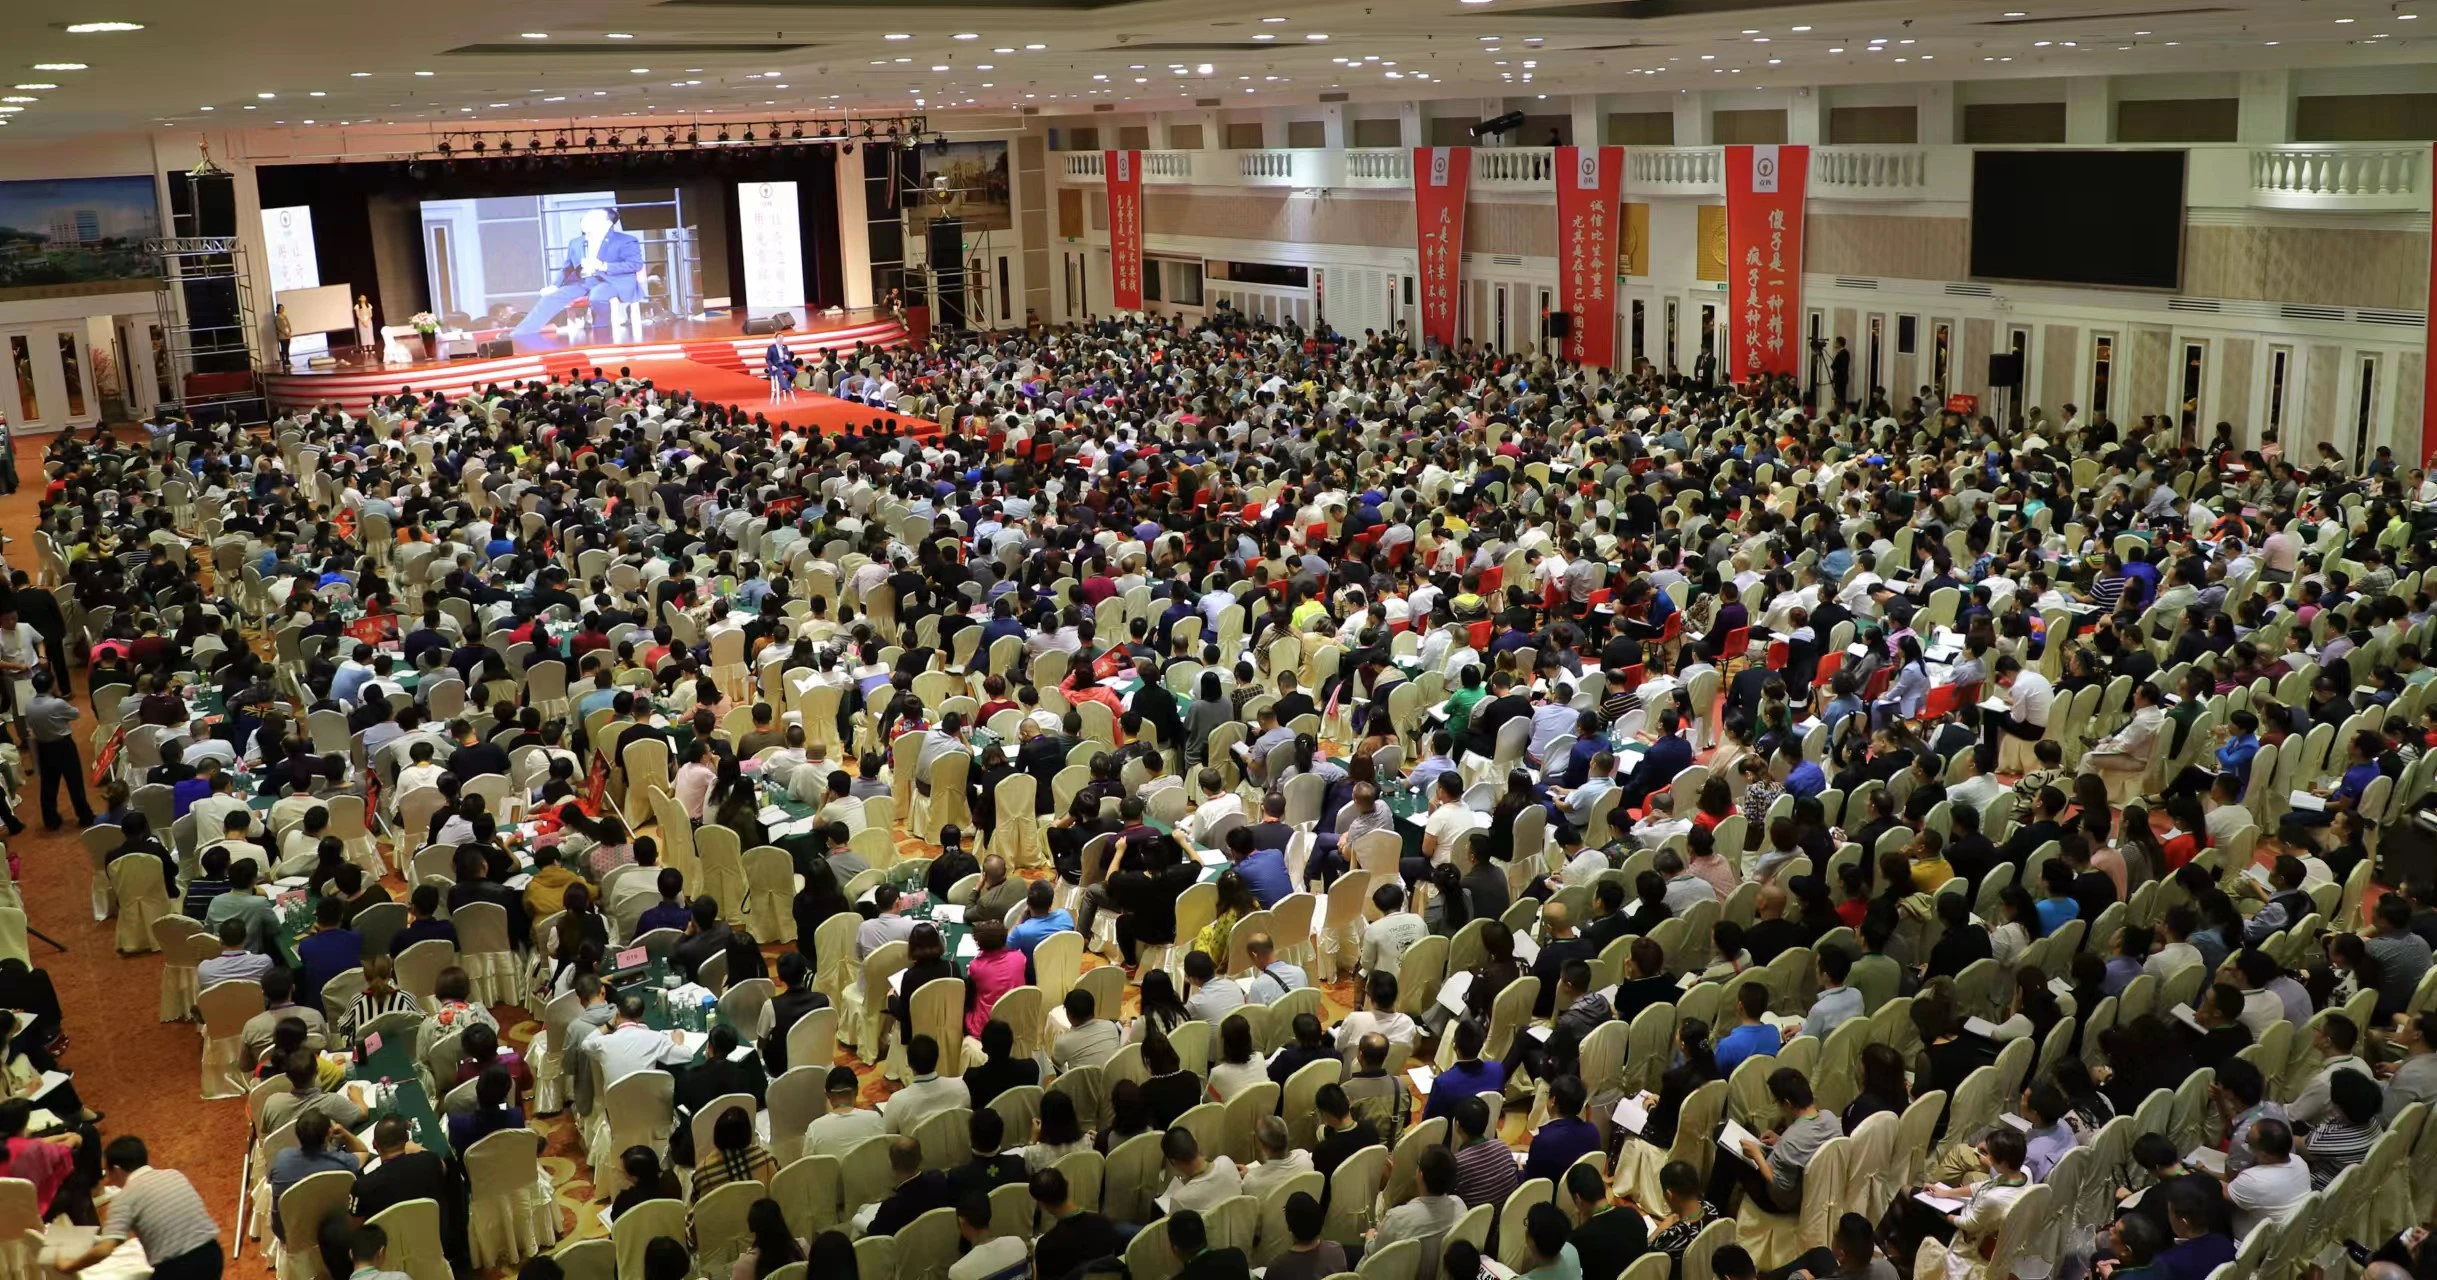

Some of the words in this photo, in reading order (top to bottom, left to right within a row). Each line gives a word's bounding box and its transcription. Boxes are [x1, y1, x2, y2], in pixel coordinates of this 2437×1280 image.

[1572, 216, 1585, 356] 尤其是在自己的圈子内
[1590, 200, 1605, 299] 诚信比生命重要
[1745, 246, 1763, 368] 疯子是种状态
[1767, 209, 1786, 355] 傻子是一种精神
